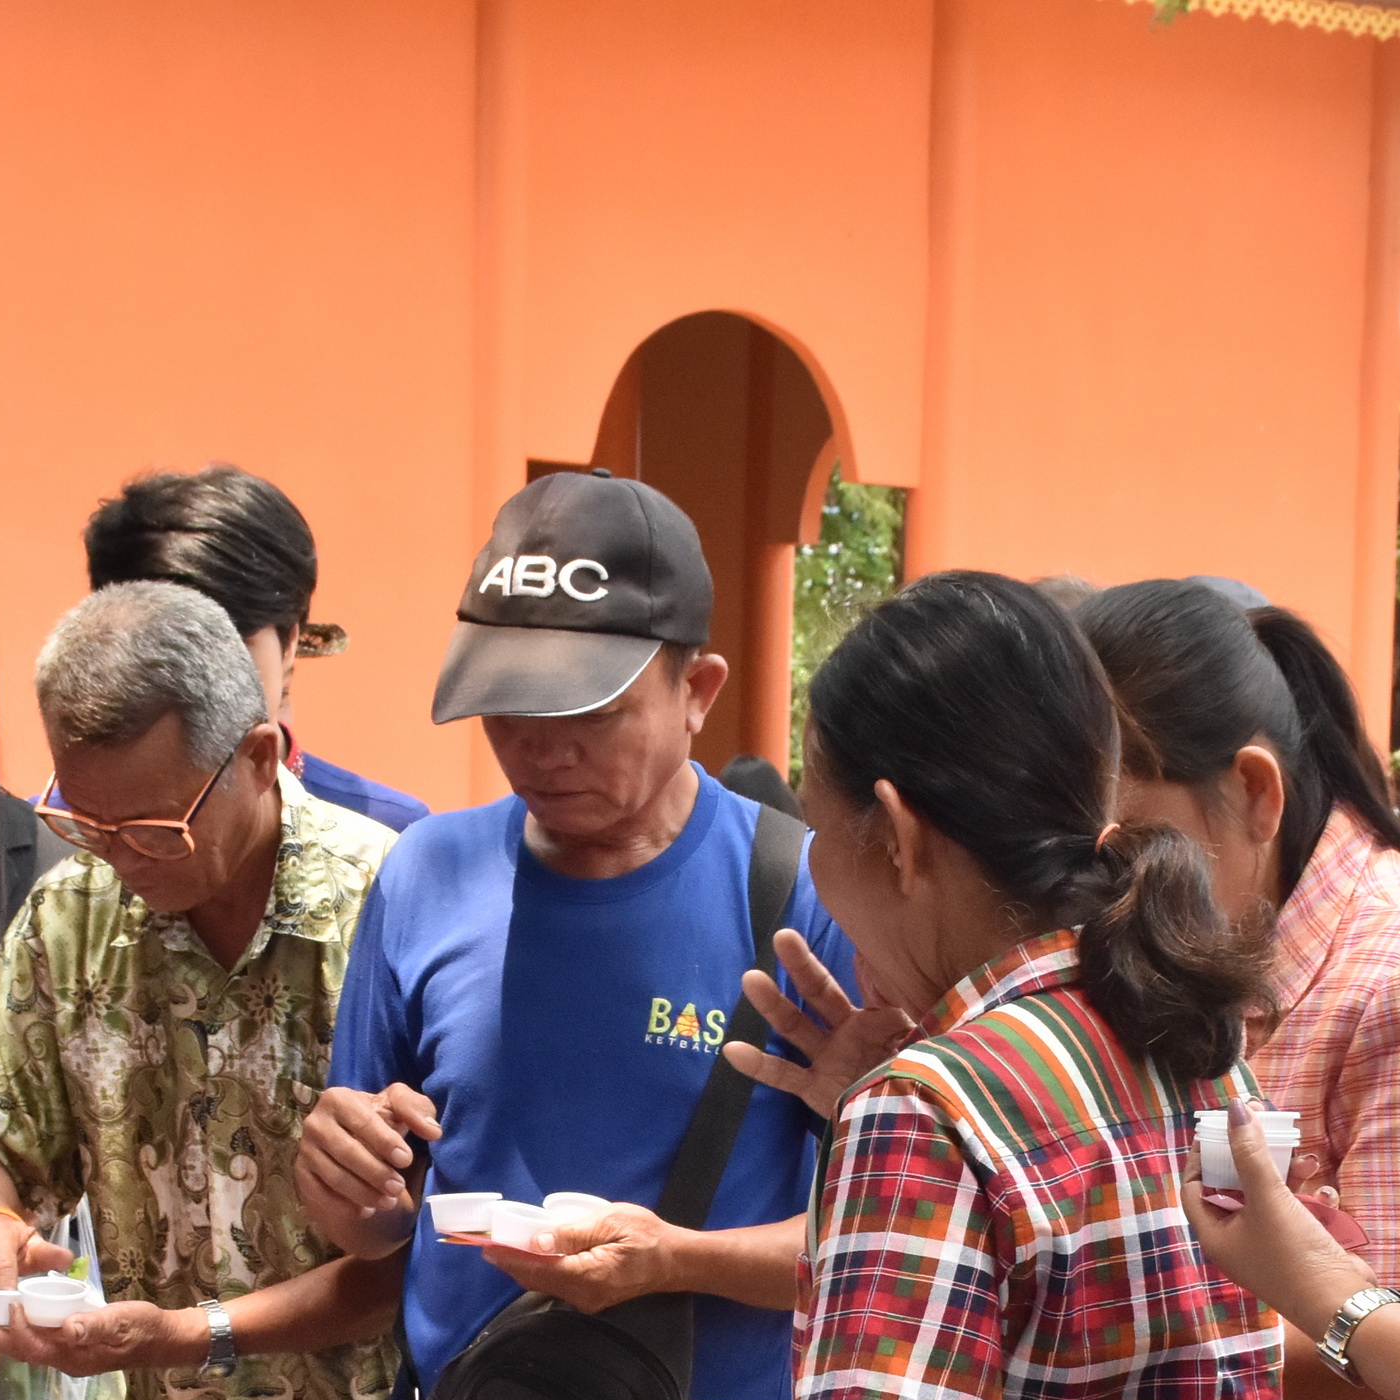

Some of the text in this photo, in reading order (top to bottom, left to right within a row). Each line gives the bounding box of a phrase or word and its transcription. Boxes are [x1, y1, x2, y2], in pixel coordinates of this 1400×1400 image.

[478, 554, 609, 602] ABC
[644, 1033, 720, 1055] KETBALL
[648, 997, 725, 1046] BAS
